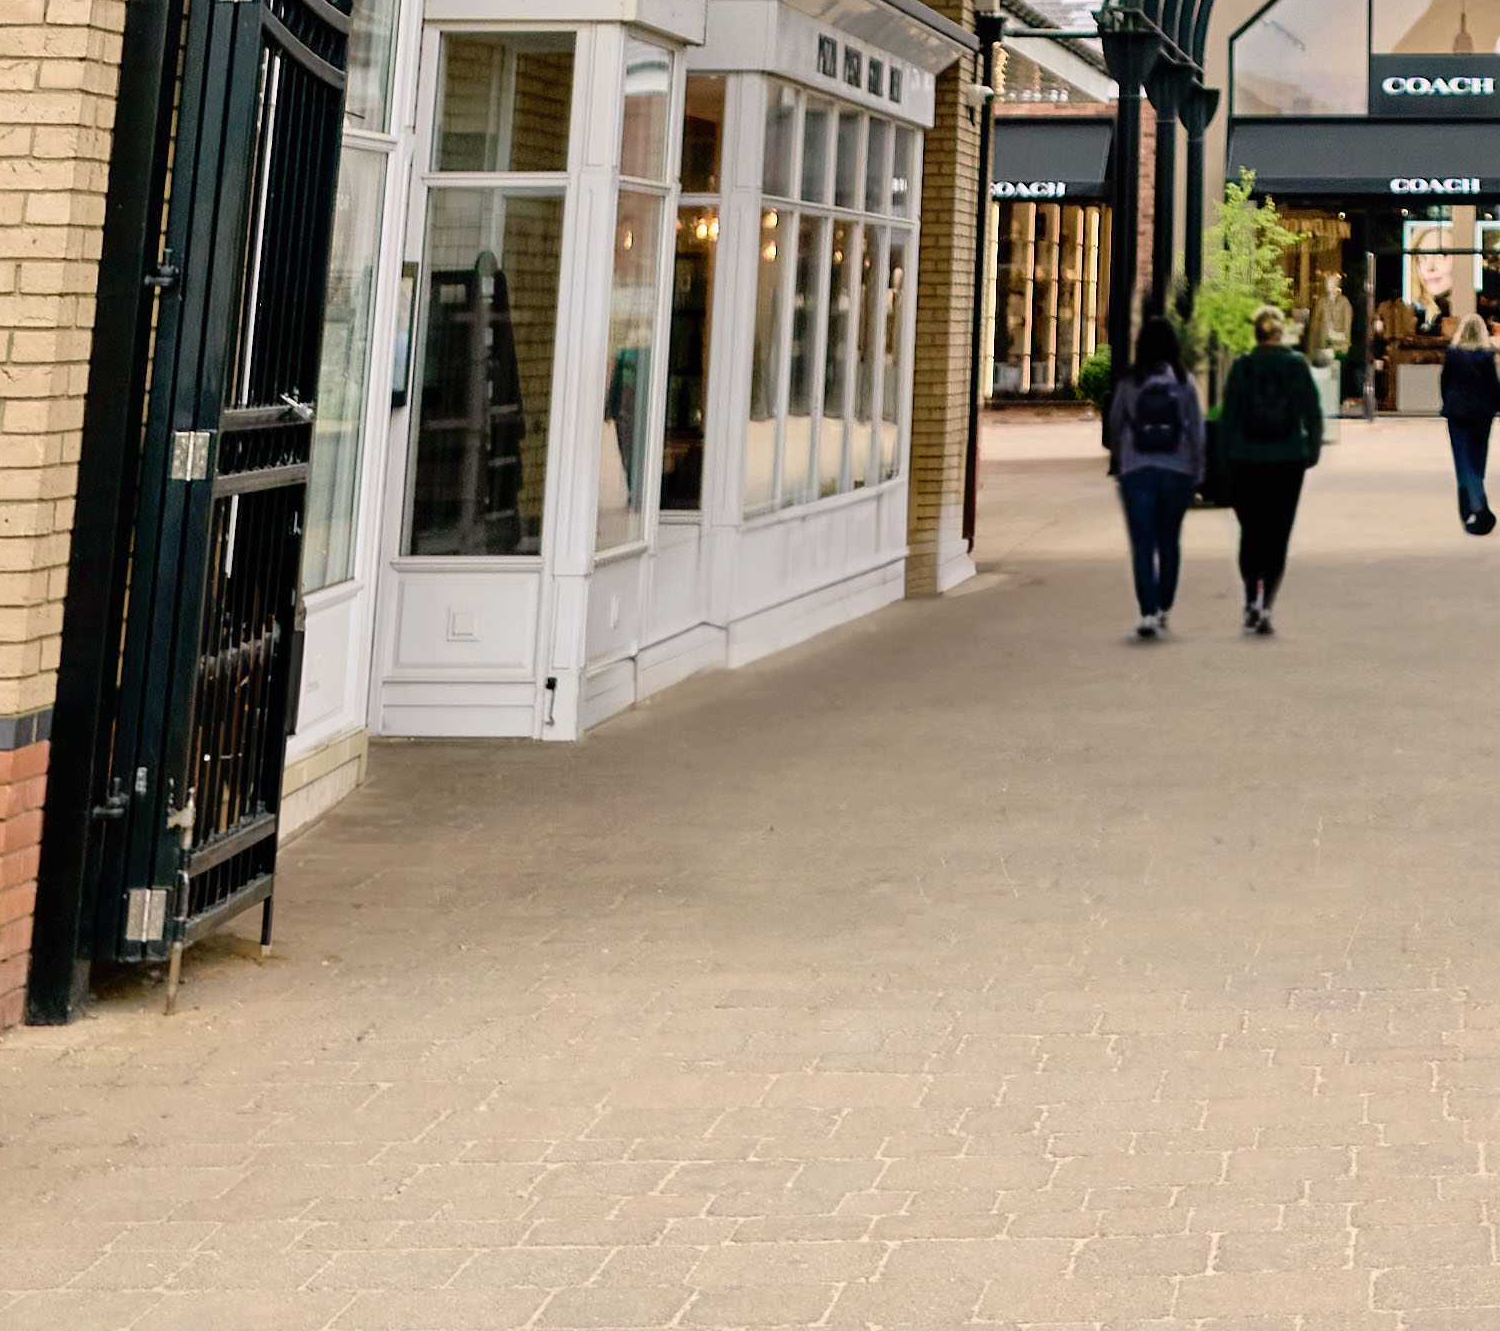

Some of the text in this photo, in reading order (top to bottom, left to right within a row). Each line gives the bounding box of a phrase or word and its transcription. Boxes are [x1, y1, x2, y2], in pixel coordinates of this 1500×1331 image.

[1382, 76, 1495, 96] COACH
[989, 180, 1066, 198] OACH
[1389, 178, 1481, 195] COACH
